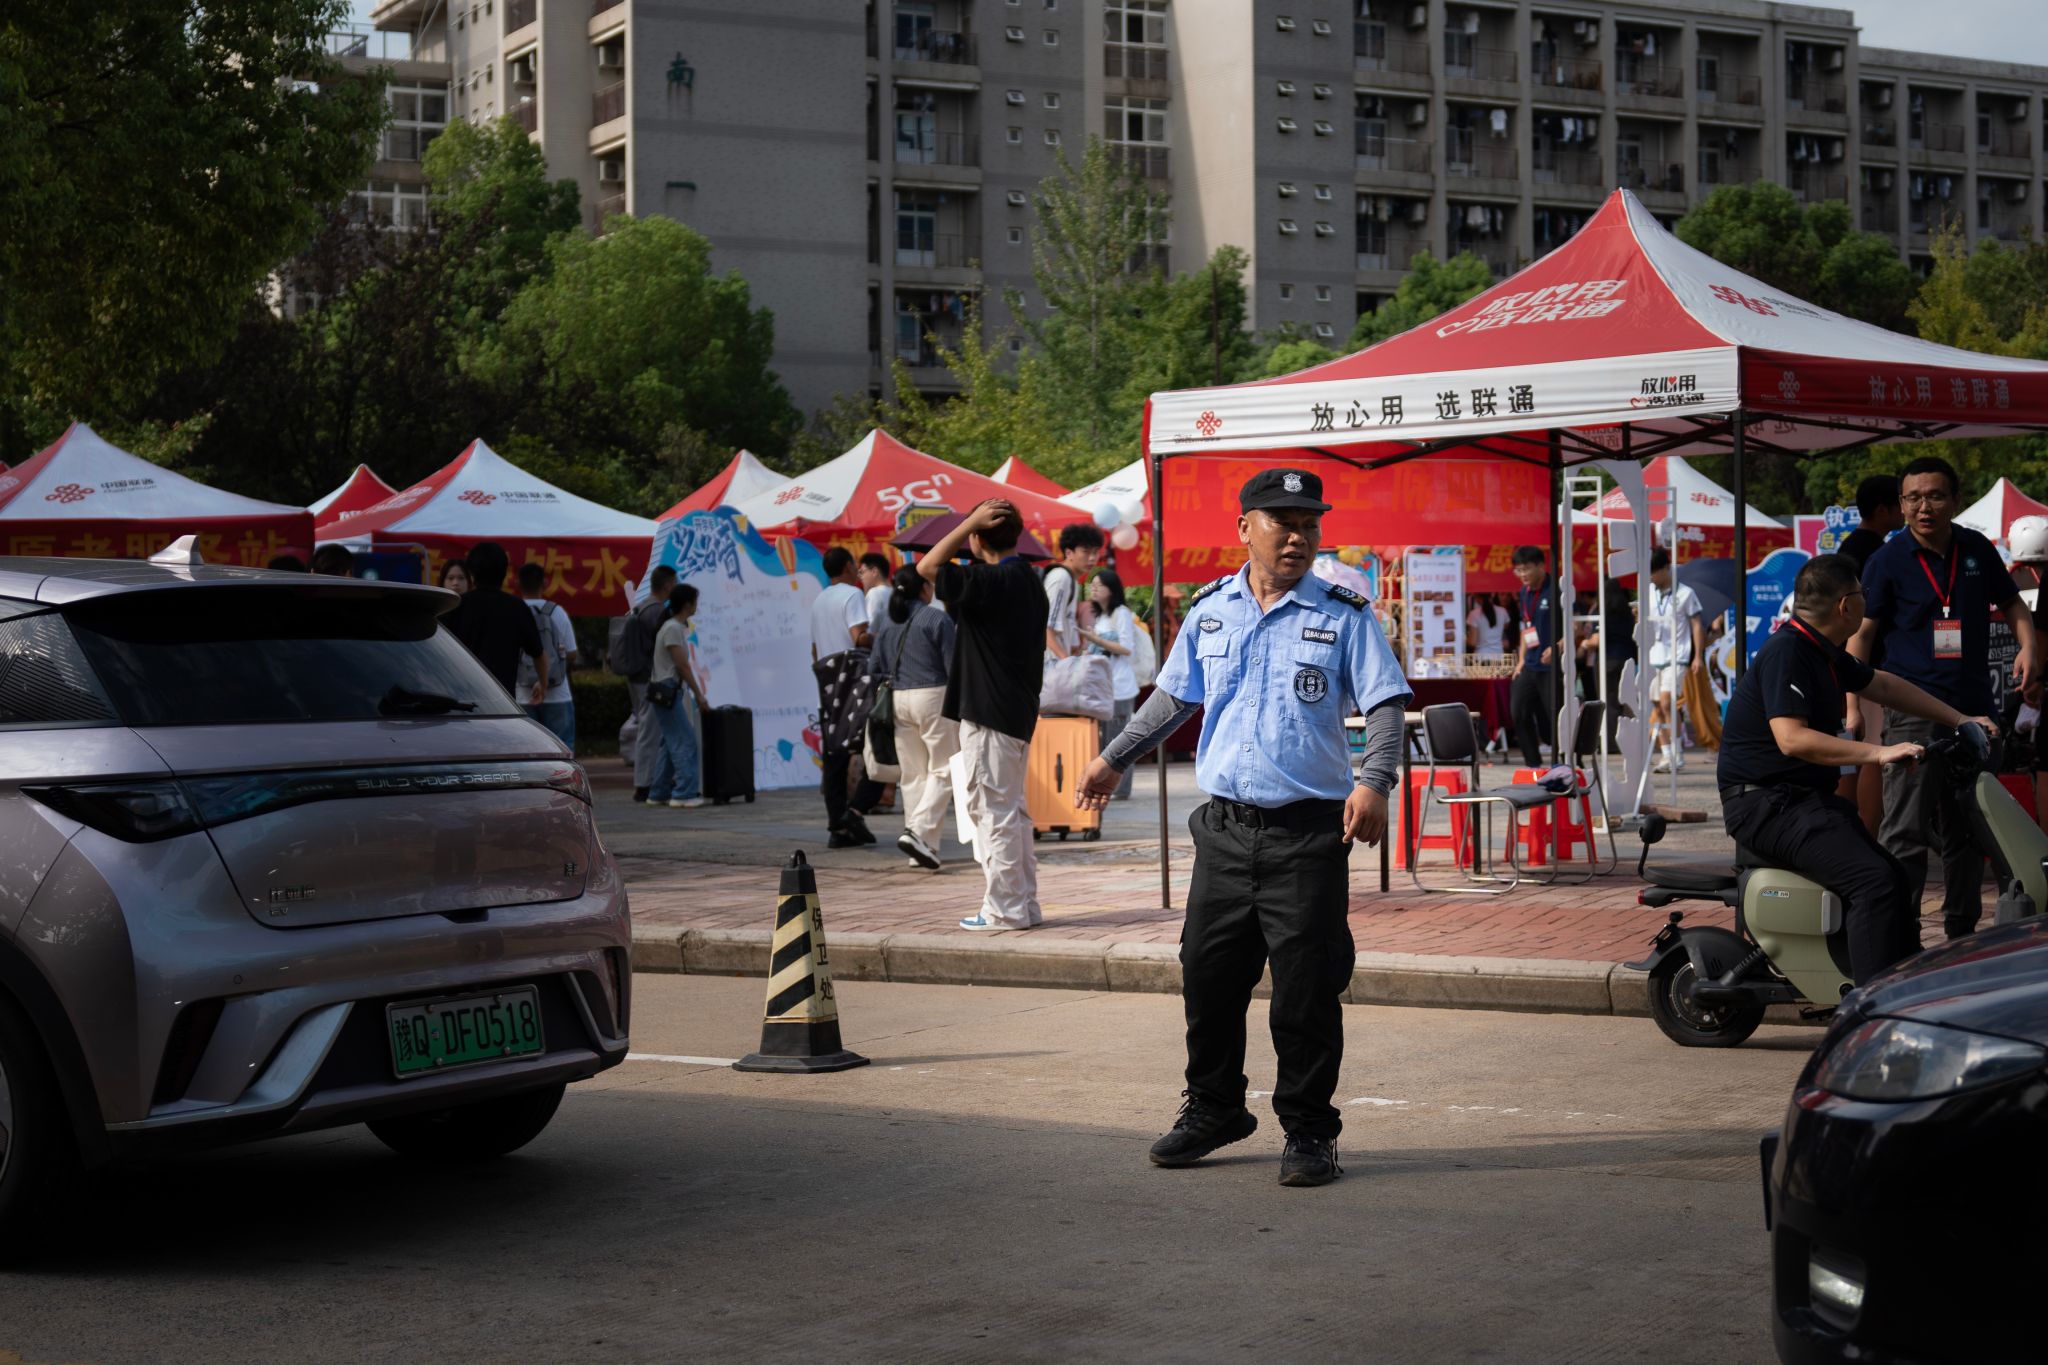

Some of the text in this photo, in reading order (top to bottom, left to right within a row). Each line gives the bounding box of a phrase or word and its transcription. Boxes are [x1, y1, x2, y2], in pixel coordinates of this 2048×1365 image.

[1474, 279, 1627, 317] 放心用
[1466, 299, 1626, 334] 选联通
[1640, 374, 1696, 395] 放心用
[1311, 384, 1535, 431] 放心用 选联通
[413, 774, 461, 787] YOUR
[462, 772, 522, 785] DREAMS
[811, 906, 834, 1001] 保卫处
